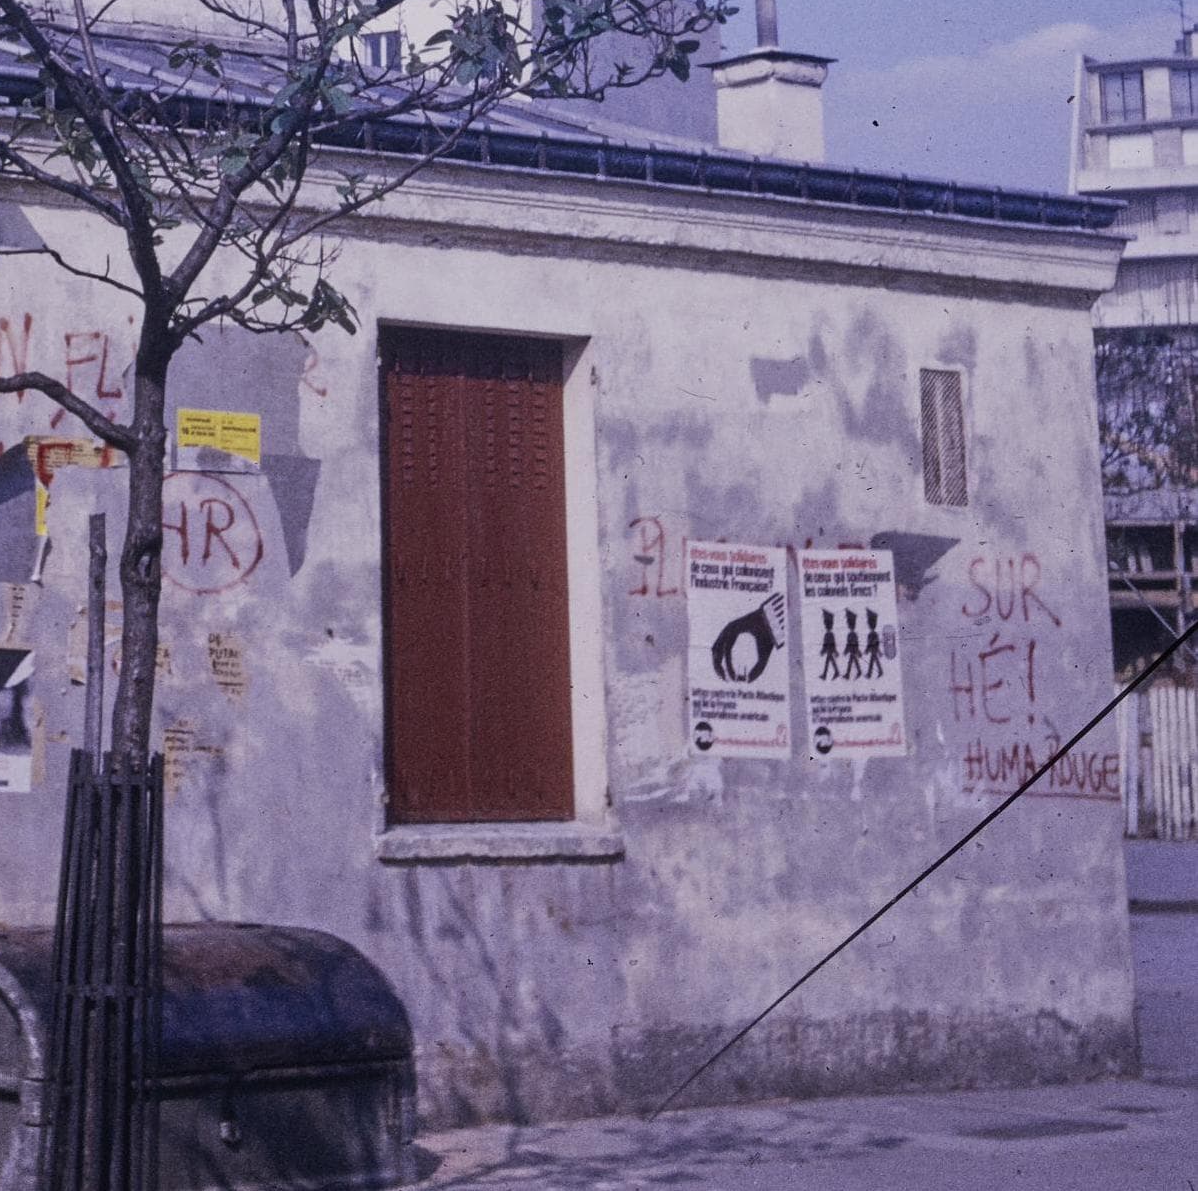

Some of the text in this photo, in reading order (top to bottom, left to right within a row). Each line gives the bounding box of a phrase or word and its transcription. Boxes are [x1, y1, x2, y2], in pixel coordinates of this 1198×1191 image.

[961, 552, 1062, 628] SUR
[962, 734, 1121, 793] HUMA ROUGE
